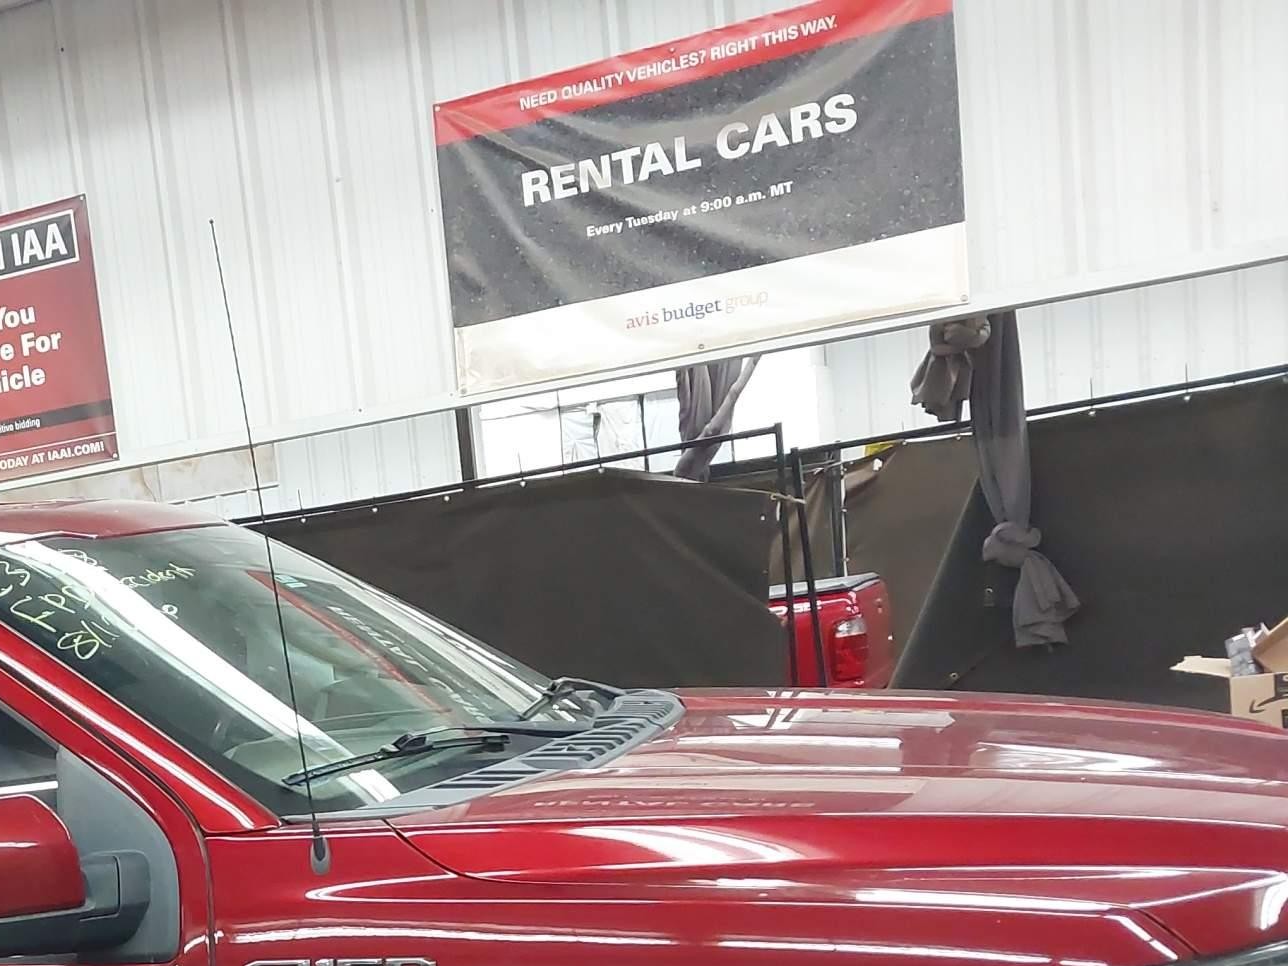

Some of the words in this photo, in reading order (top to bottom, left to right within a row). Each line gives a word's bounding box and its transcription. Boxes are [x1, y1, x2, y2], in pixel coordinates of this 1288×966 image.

[519, 91, 558, 111] NEED
[561, 72, 624, 101] QUALITY
[626, 51, 707, 86] VEHICLES?
[710, 36, 759, 62] RIGHT
[760, 25, 799, 47] THIS
[799, 15, 838, 38] WAY.
[521, 136, 702, 208] RENTAL
[716, 93, 858, 160] CARS
[586, 220, 623, 238] Every
[625, 209, 679, 229] Tuesday
[683, 204, 697, 216] at
[700, 196, 732, 213] 9:00
[735, 190, 766, 205] a.m.
[769, 181, 794, 197] MT
[11, 222, 69, 266] IAA
[625, 311, 660, 329] avis
[662, 300, 722, 322] budget
[725, 291, 769, 314] group
[20, 331, 62, 357] For
[14, 417, 41, 430] bidding
[31, 453, 46, 465] AT
[47, 441, 105, 461] IAAI.COM!
